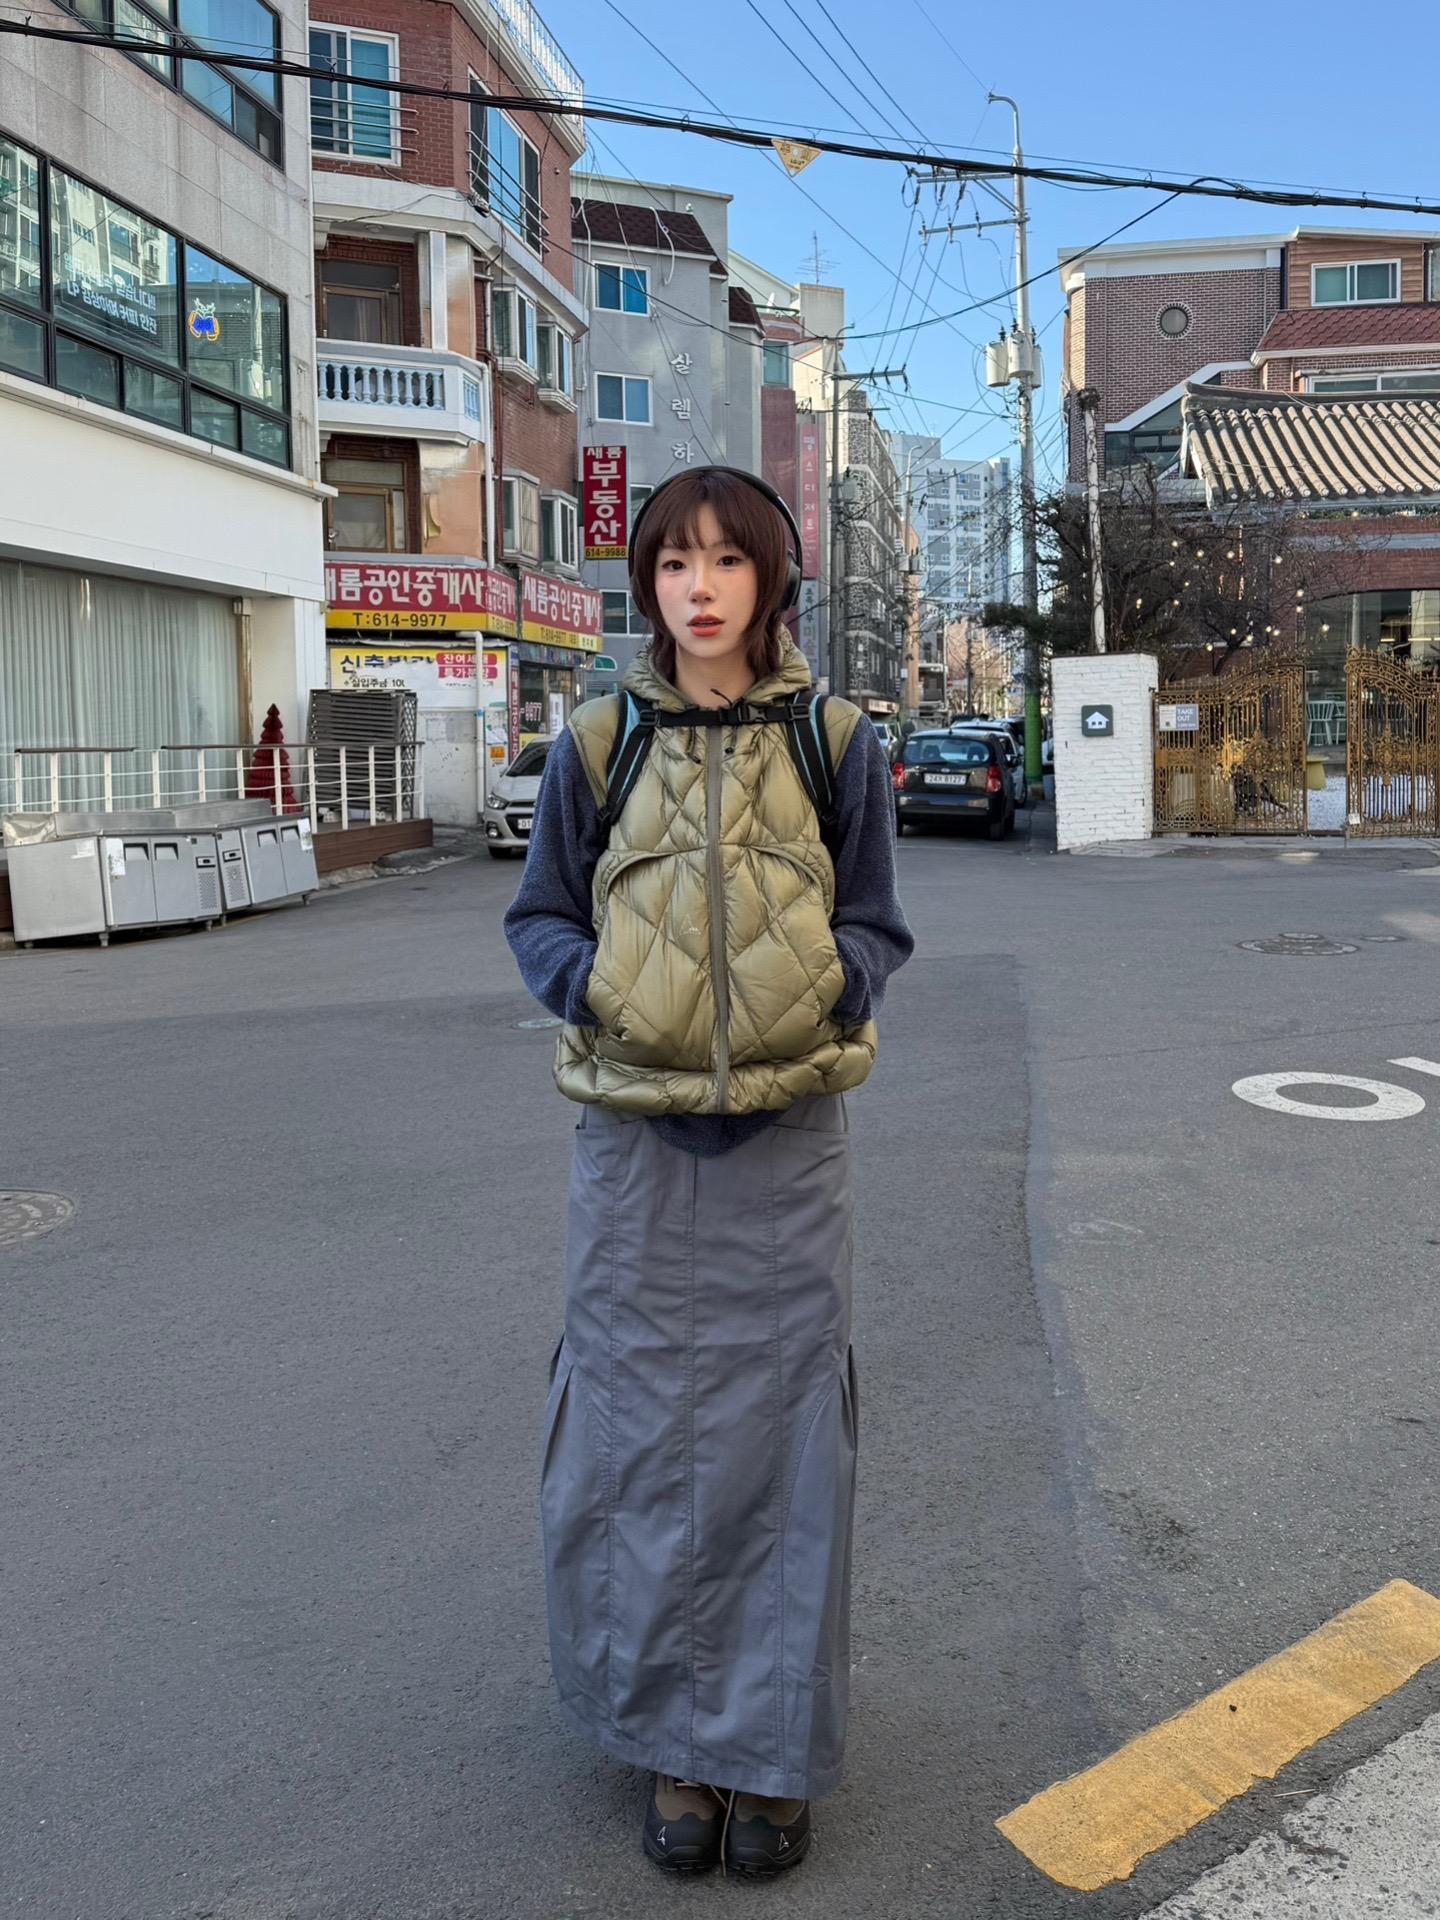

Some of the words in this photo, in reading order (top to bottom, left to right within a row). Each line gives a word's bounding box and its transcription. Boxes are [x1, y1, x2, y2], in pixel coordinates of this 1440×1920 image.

[589, 460, 622, 546] 부동산
[585, 547, 626, 558] 614-9988
[524, 576, 601, 627] 새롬공인중개사
[352, 612, 447, 627] T:614-9977
[340, 654, 433, 673] 신축
